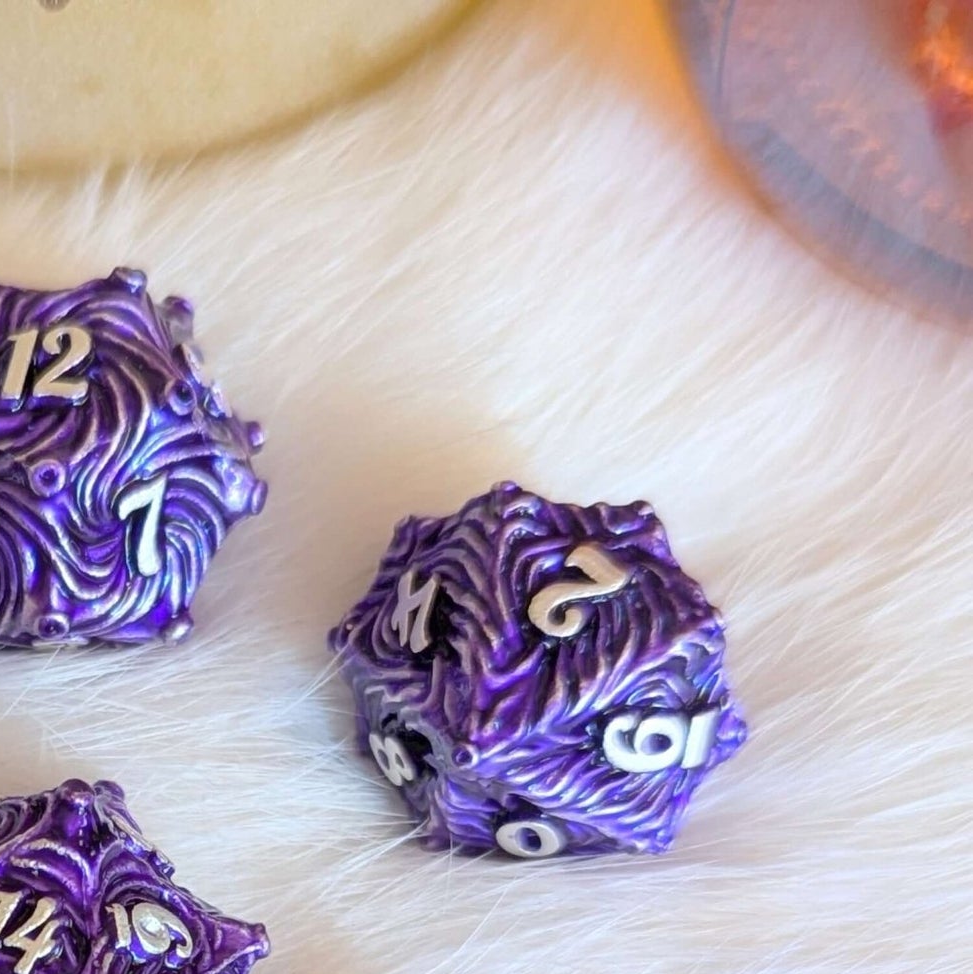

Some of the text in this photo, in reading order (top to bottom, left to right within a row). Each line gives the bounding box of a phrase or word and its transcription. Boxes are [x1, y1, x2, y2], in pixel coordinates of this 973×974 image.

[0, 326, 92, 402] 12
[119, 478, 168, 577] 7
[527, 544, 627, 638] 2
[369, 733, 414, 787] 8
[495, 821, 565, 858] 0
